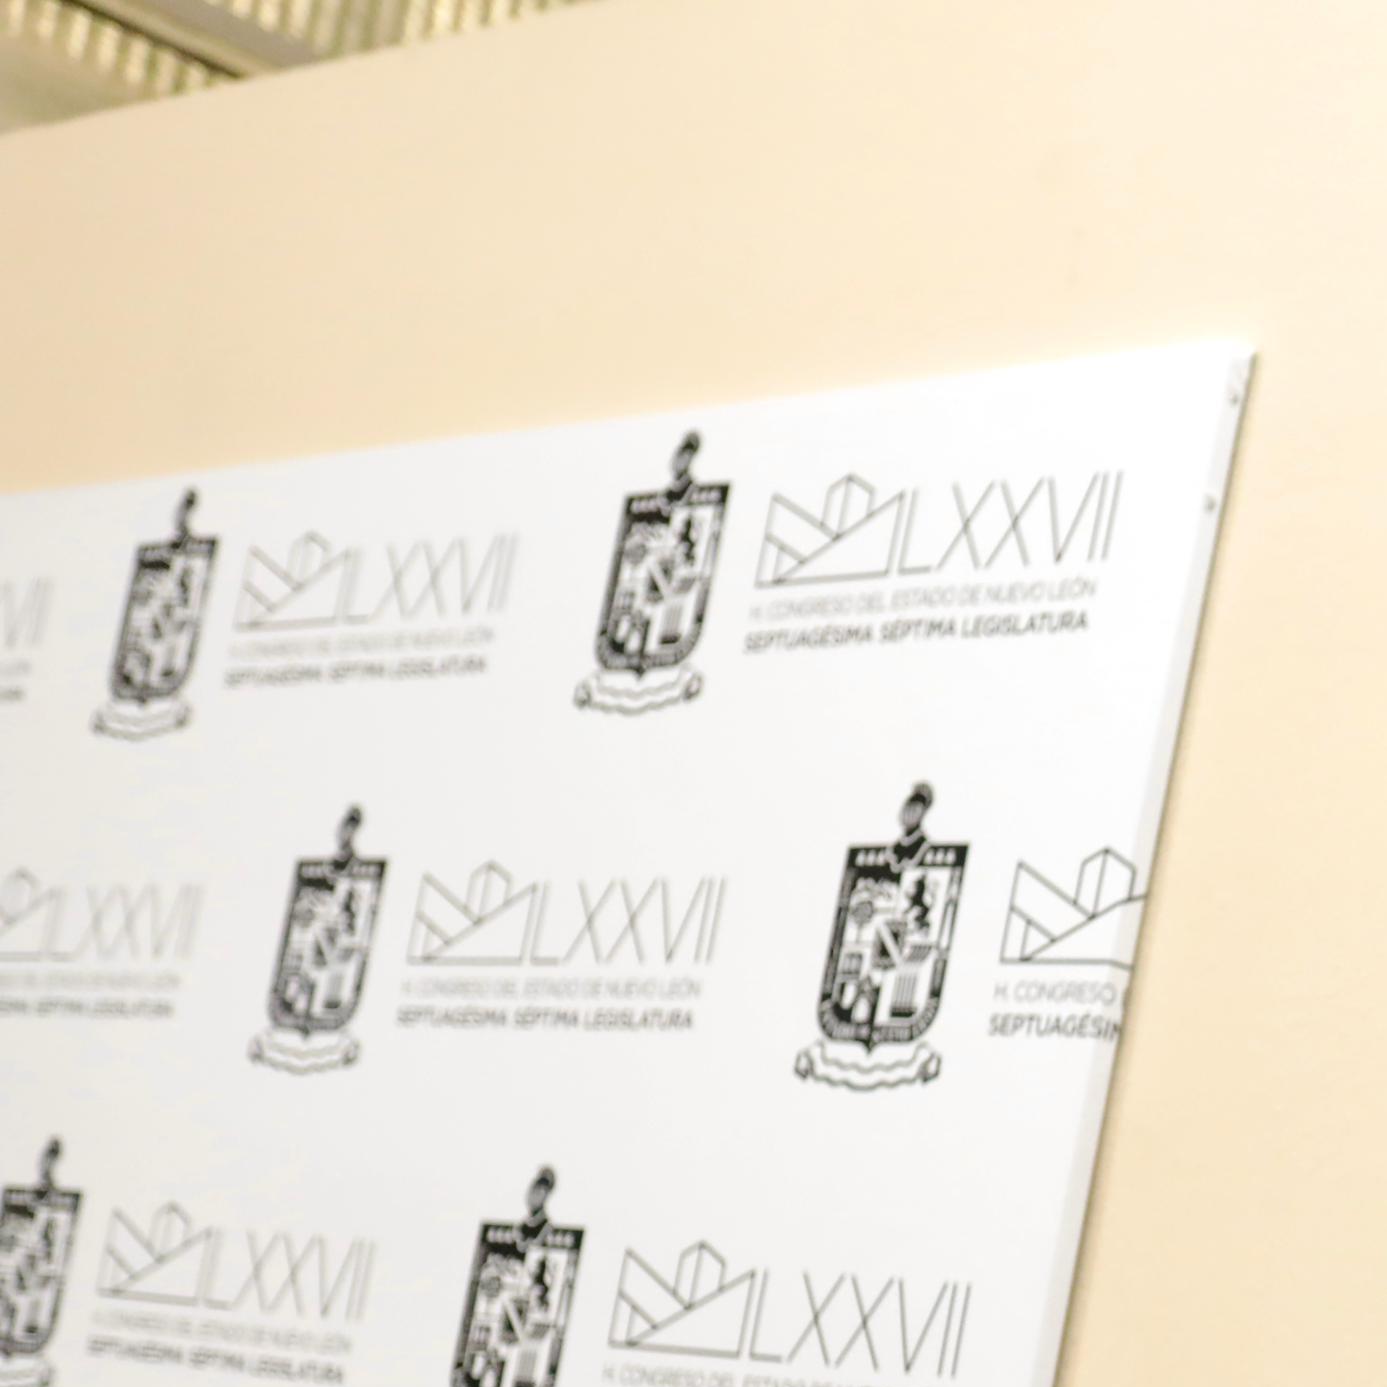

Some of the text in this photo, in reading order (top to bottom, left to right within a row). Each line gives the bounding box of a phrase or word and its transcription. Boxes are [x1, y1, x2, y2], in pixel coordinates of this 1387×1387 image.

[897, 470, 1123, 575] LXXVII
[744, 610, 1088, 654] SEPTUAGÉSIMA SÉPTIMA LEGISLATURA
[529, 875, 729, 967] LXXVII
[748, 1268, 972, 1379] LXXVII
